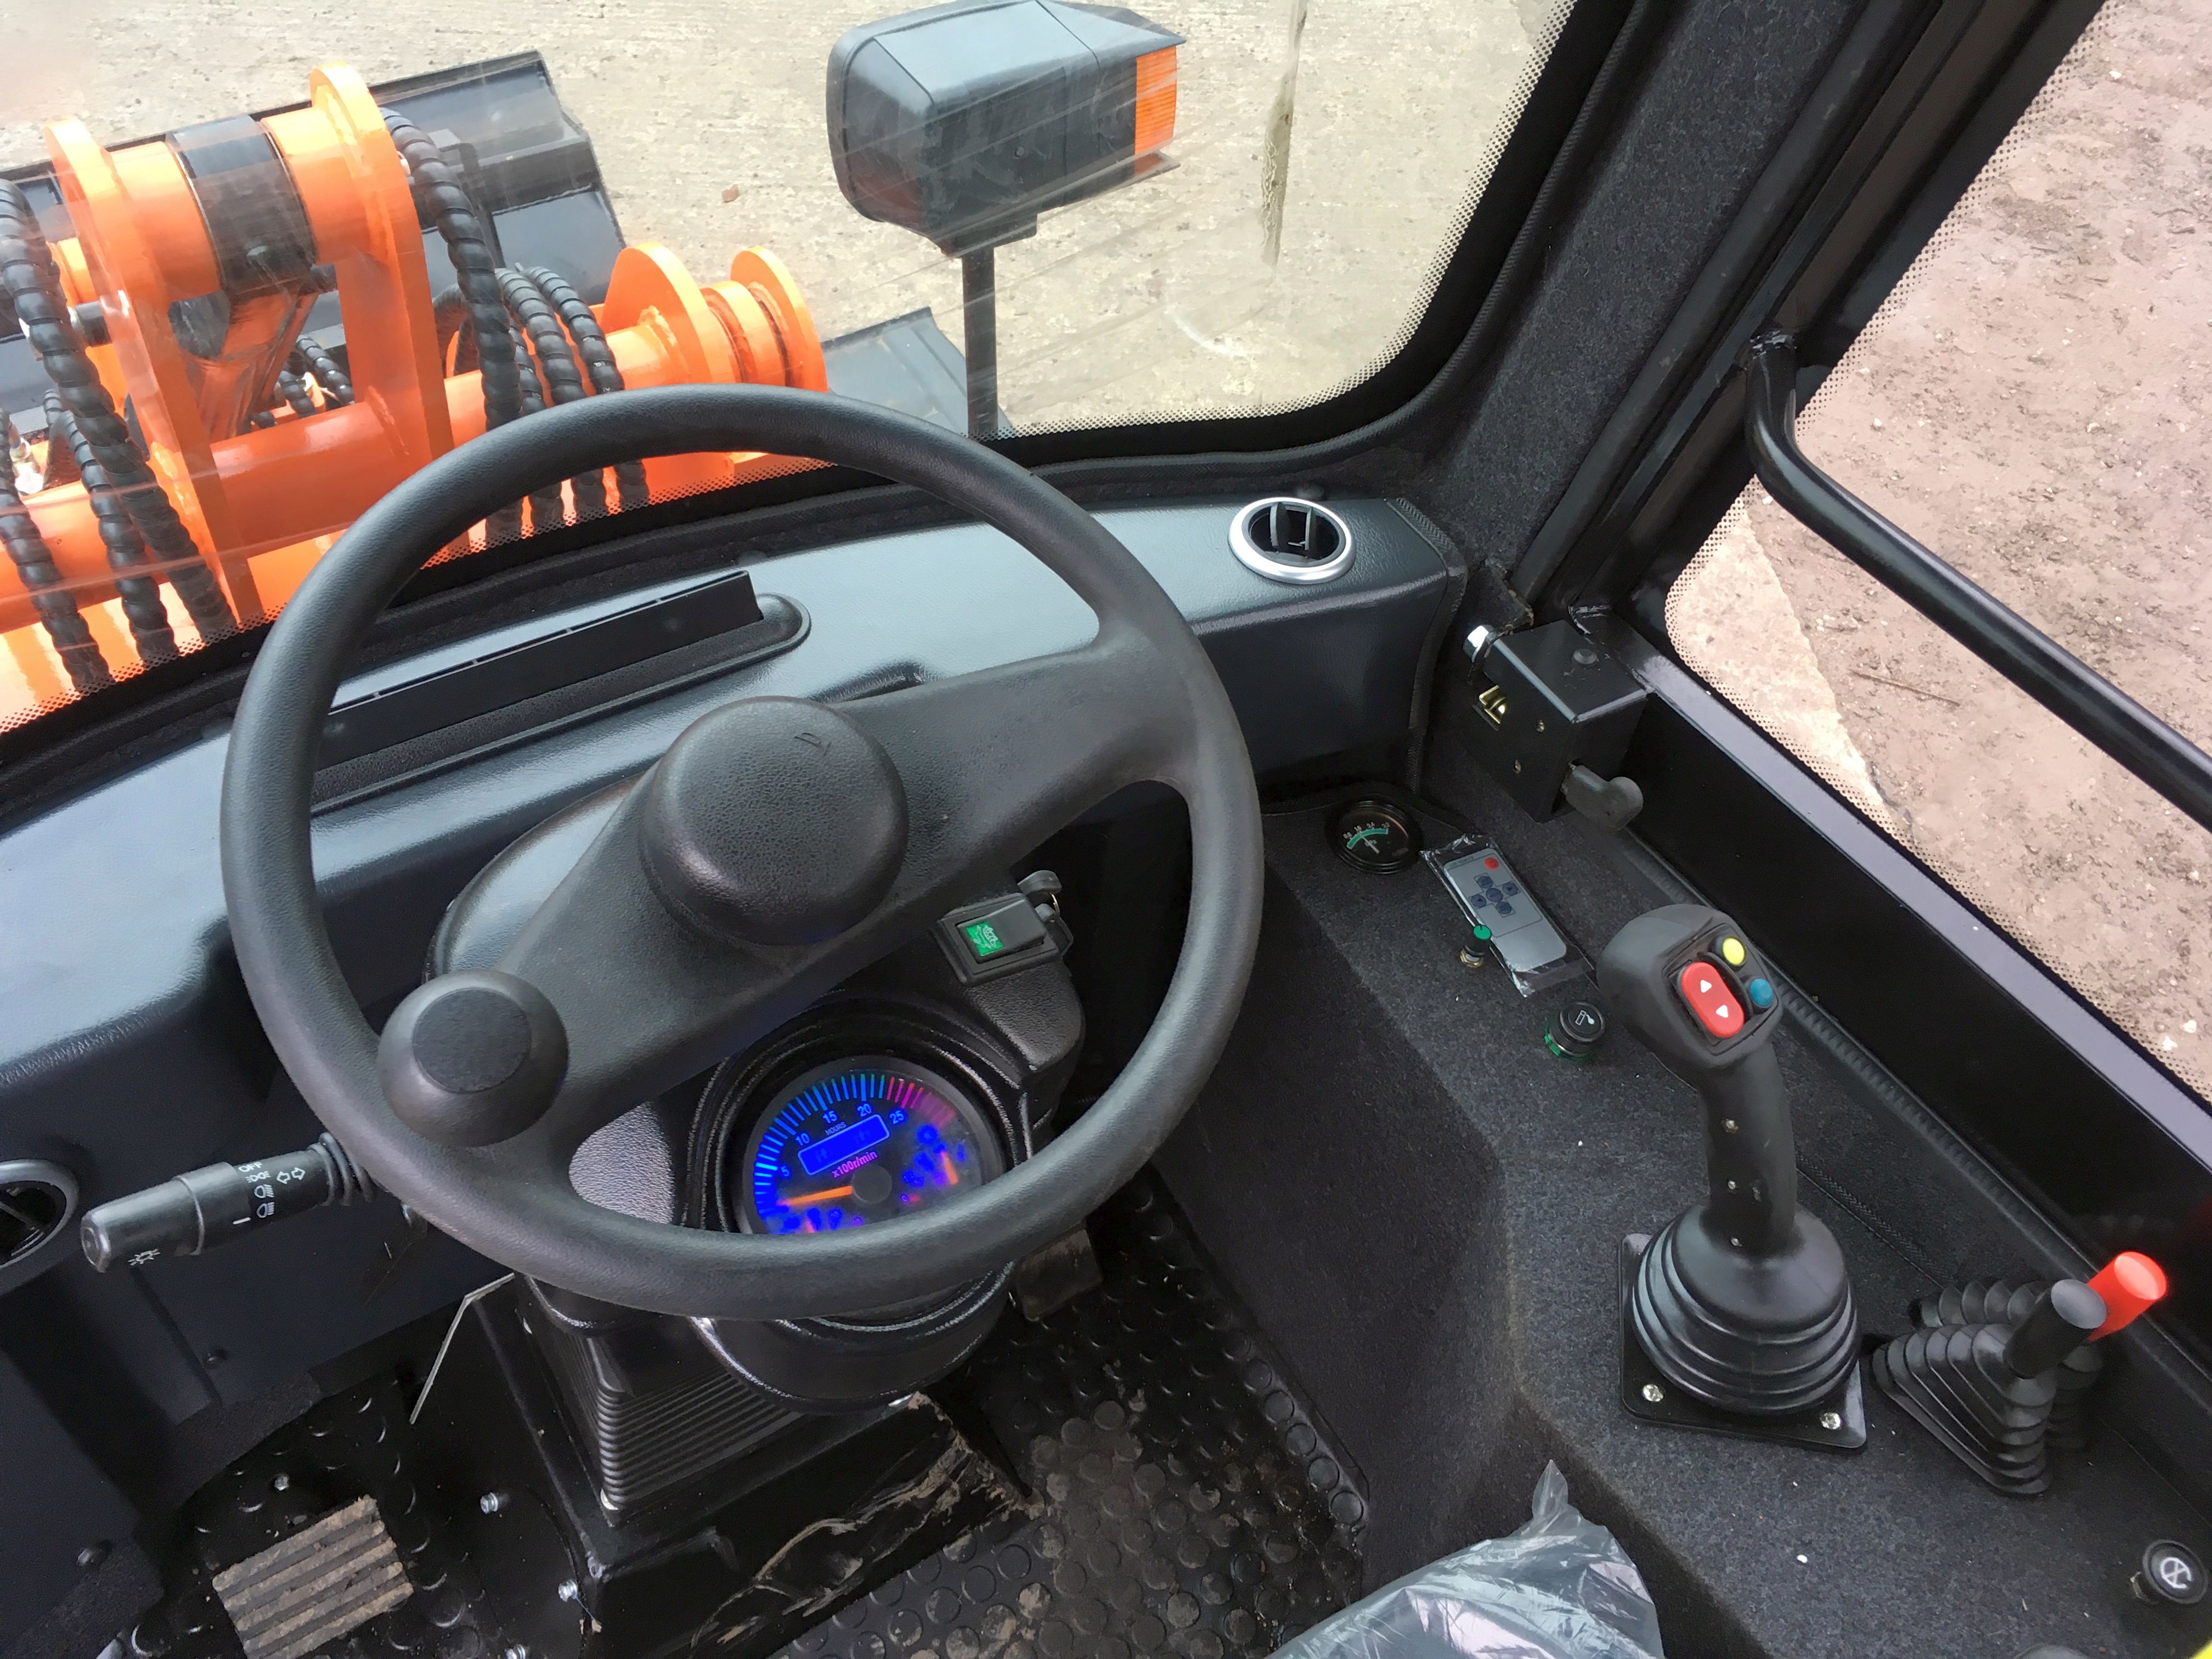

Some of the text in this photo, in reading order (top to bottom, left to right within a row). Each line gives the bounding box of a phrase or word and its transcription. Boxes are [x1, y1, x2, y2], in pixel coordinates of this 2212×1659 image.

[822, 1110, 838, 1124] 15
[857, 1103, 872, 1117] 20
[889, 1110, 905, 1125] 25
[825, 1121, 847, 1136] HOURS
[795, 1132, 810, 1146] 10
[238, 1161, 263, 1173] OFF
[781, 1166, 791, 1177] 5
[831, 1151, 878, 1178] x100r/min
